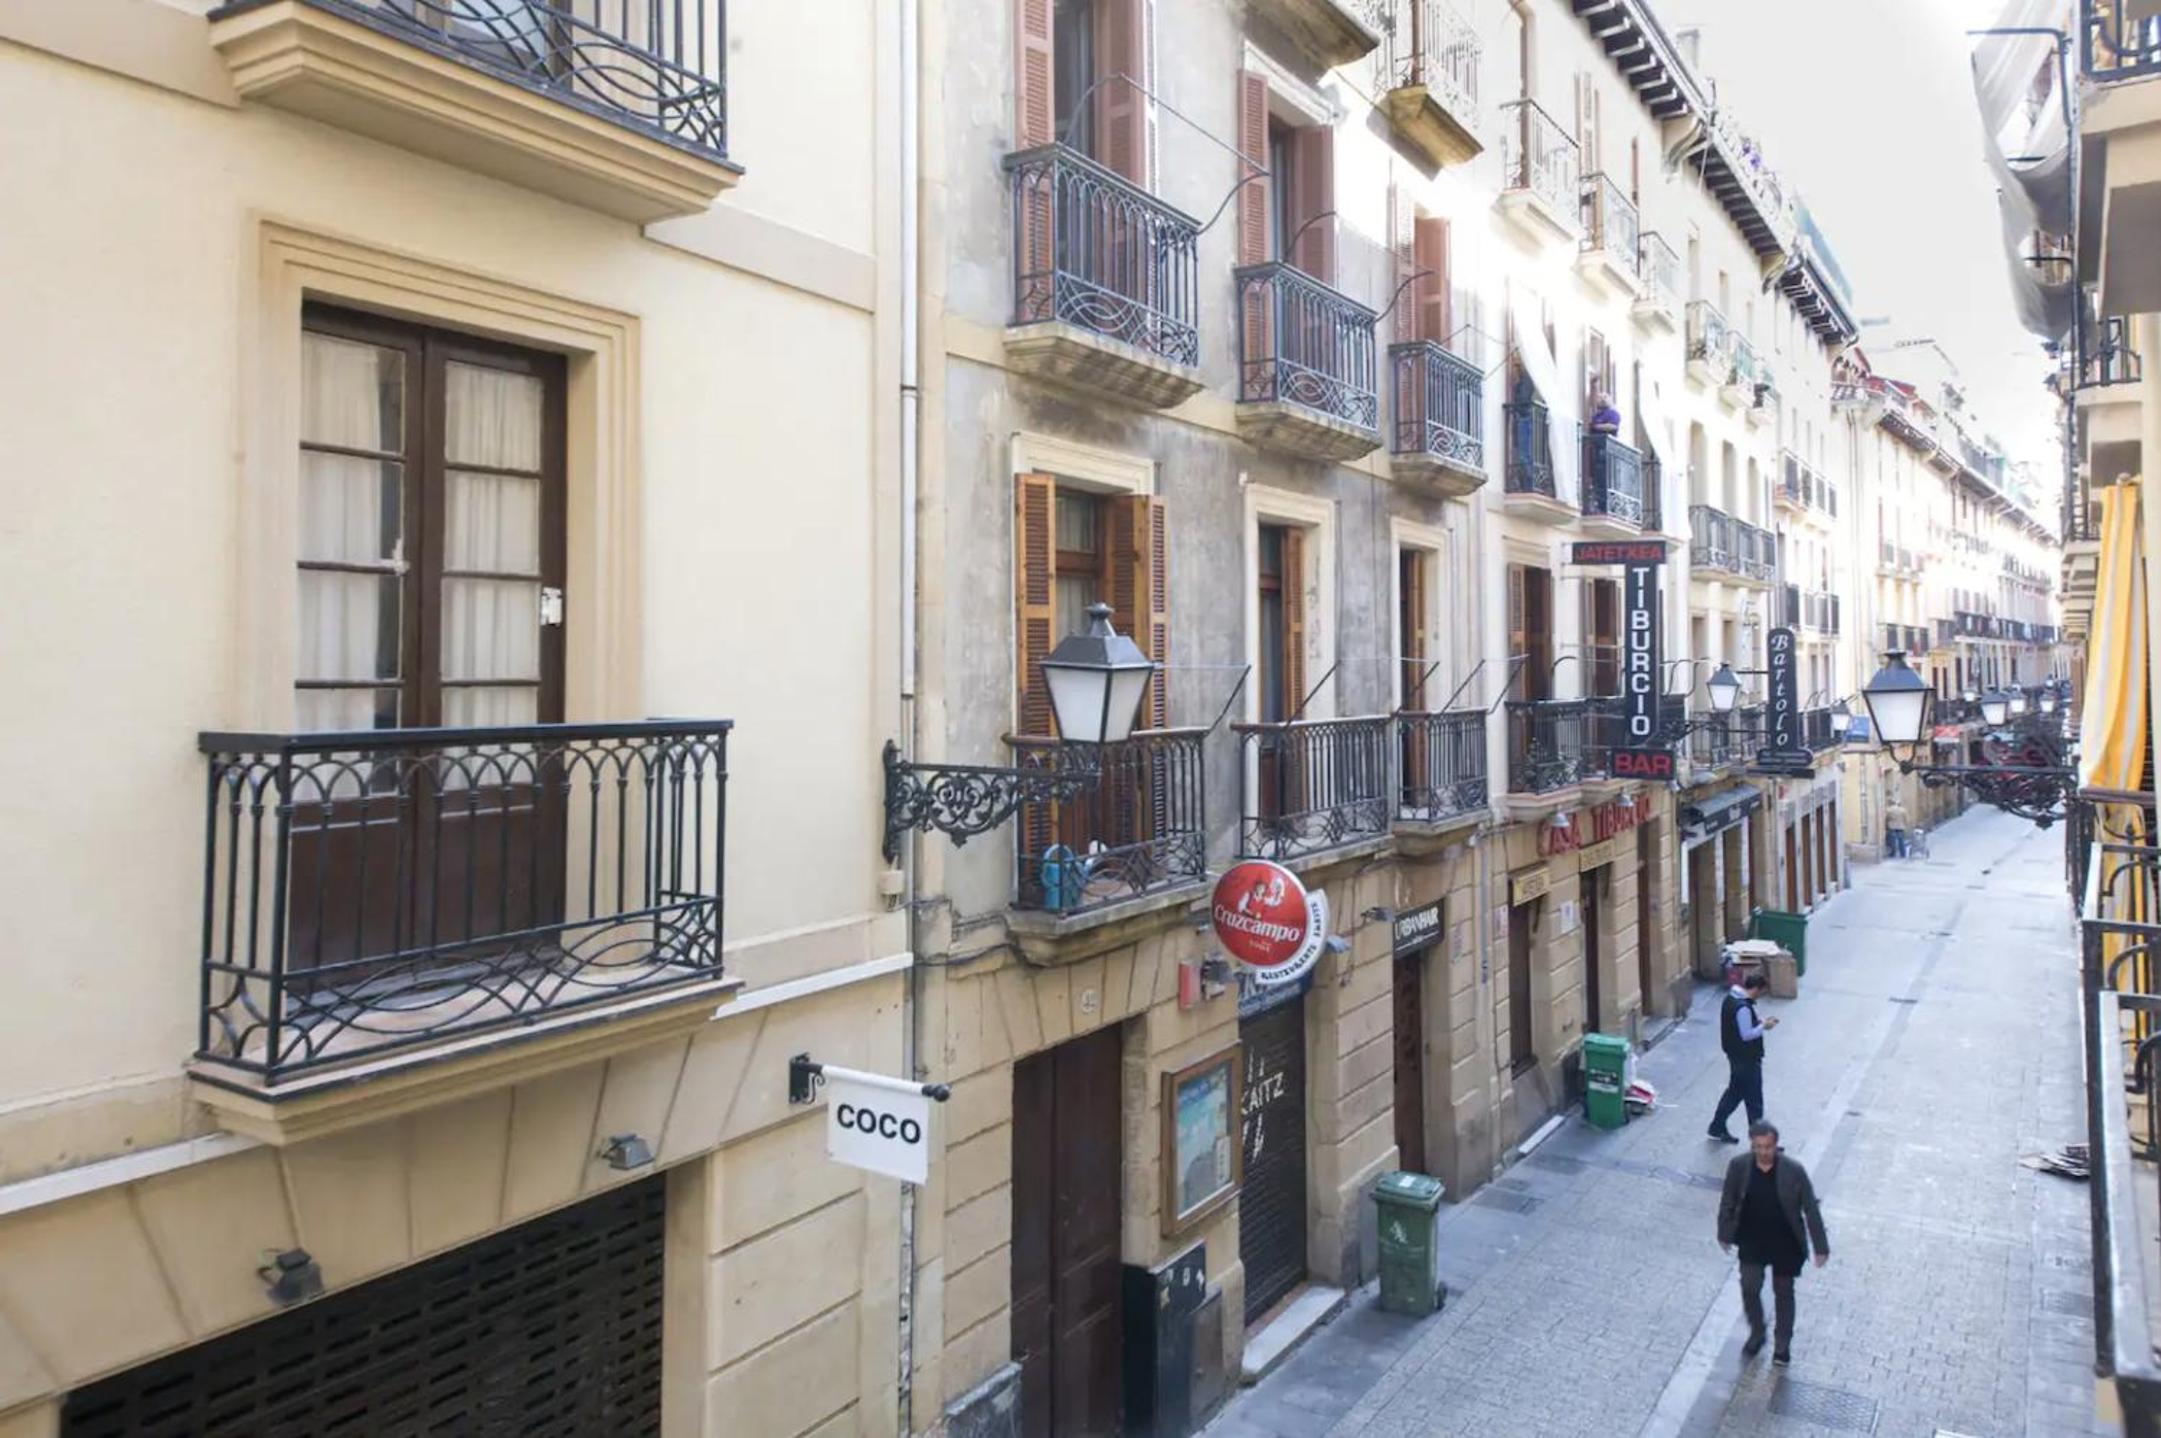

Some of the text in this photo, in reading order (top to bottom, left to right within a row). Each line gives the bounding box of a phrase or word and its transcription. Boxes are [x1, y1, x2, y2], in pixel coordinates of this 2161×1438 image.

[1631, 566, 1651, 736] TIBURCIO
[1770, 634, 1789, 746] Bartolo
[1613, 754, 1671, 776] BAR
[1213, 903, 1300, 943] Cruzcampo
[836, 1103, 922, 1145] COCO
